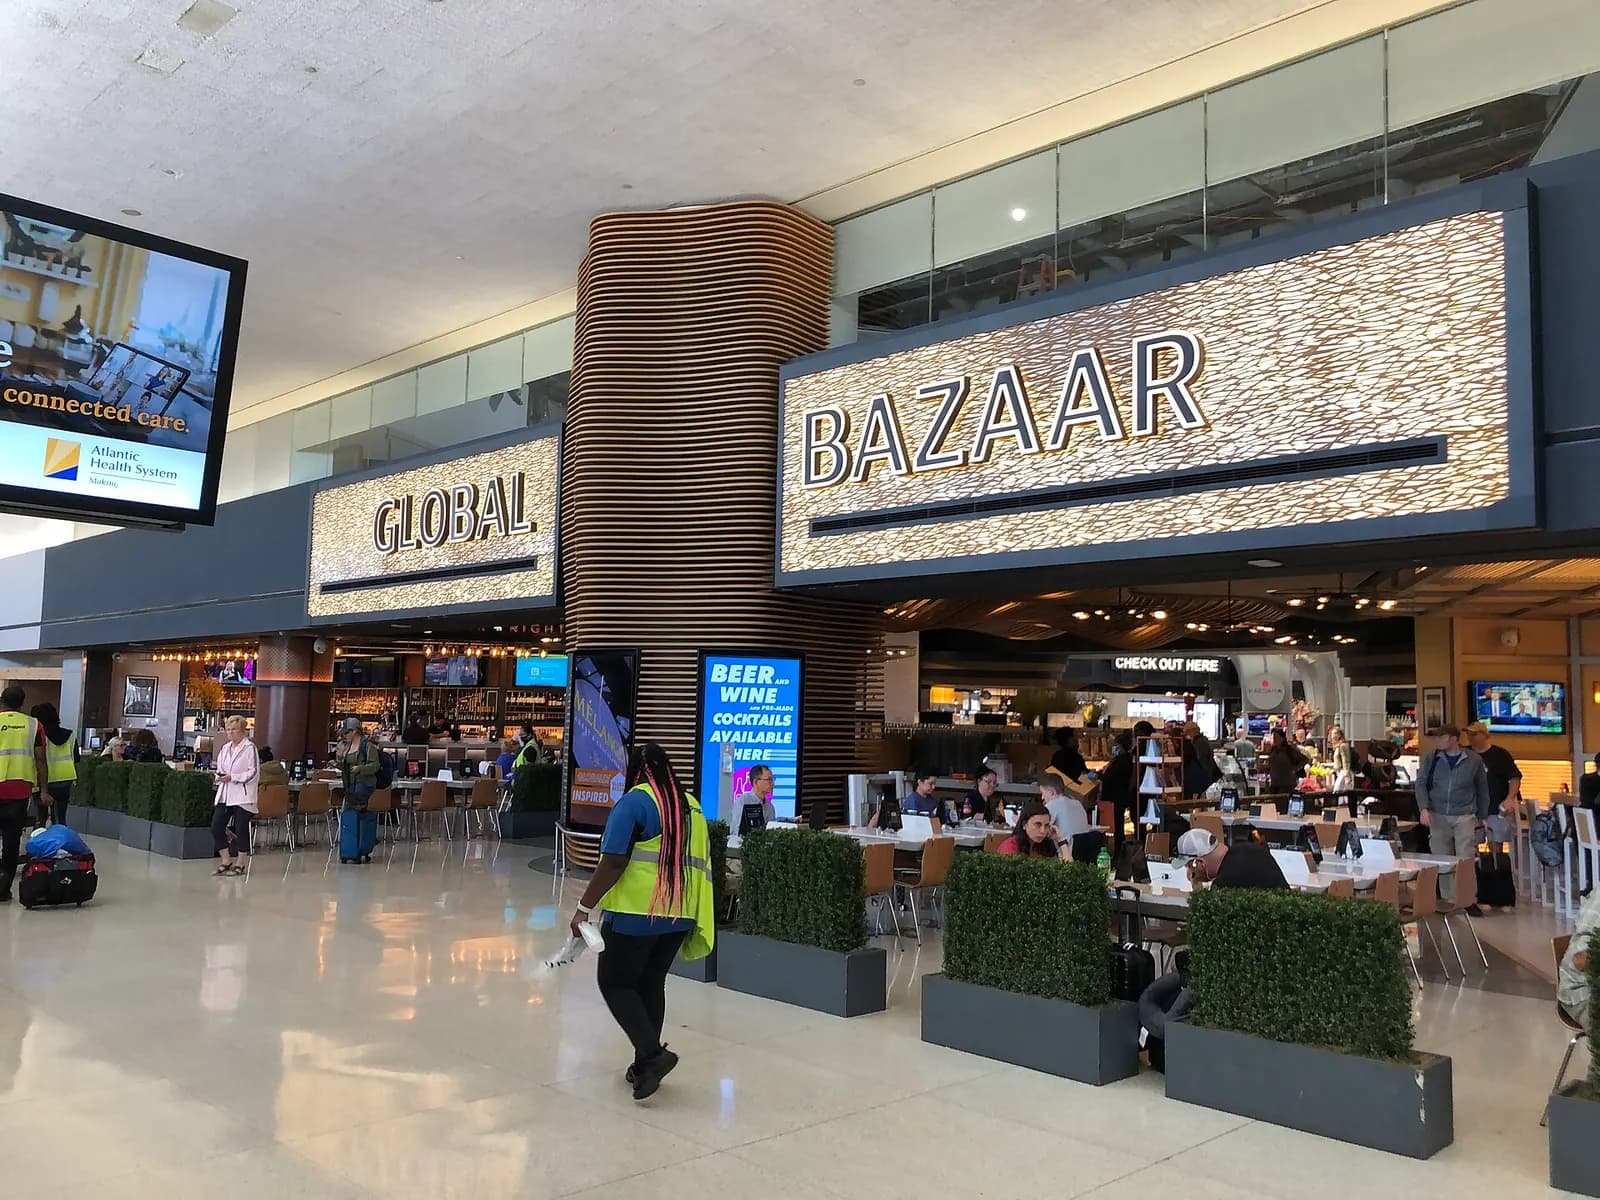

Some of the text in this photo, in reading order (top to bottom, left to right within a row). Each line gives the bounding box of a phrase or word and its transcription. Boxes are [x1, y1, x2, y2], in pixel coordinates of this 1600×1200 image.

[3, 387, 190, 433] connected care.
[801, 328, 1208, 490] BAZAAR
[91, 445, 140, 462] Atlantic
[90, 458, 178, 480] Health System
[373, 471, 536, 555] GLOBAL
[1115, 657, 1220, 672] CHECK OUT HERE
[710, 663, 775, 685] BEER
[720, 686, 778, 704] WINE
[713, 712, 792, 726] COCKTAILS
[709, 730, 793, 744] AVAILABLE
[734, 748, 771, 761] HERE
[572, 790, 609, 803] INSPIRED
